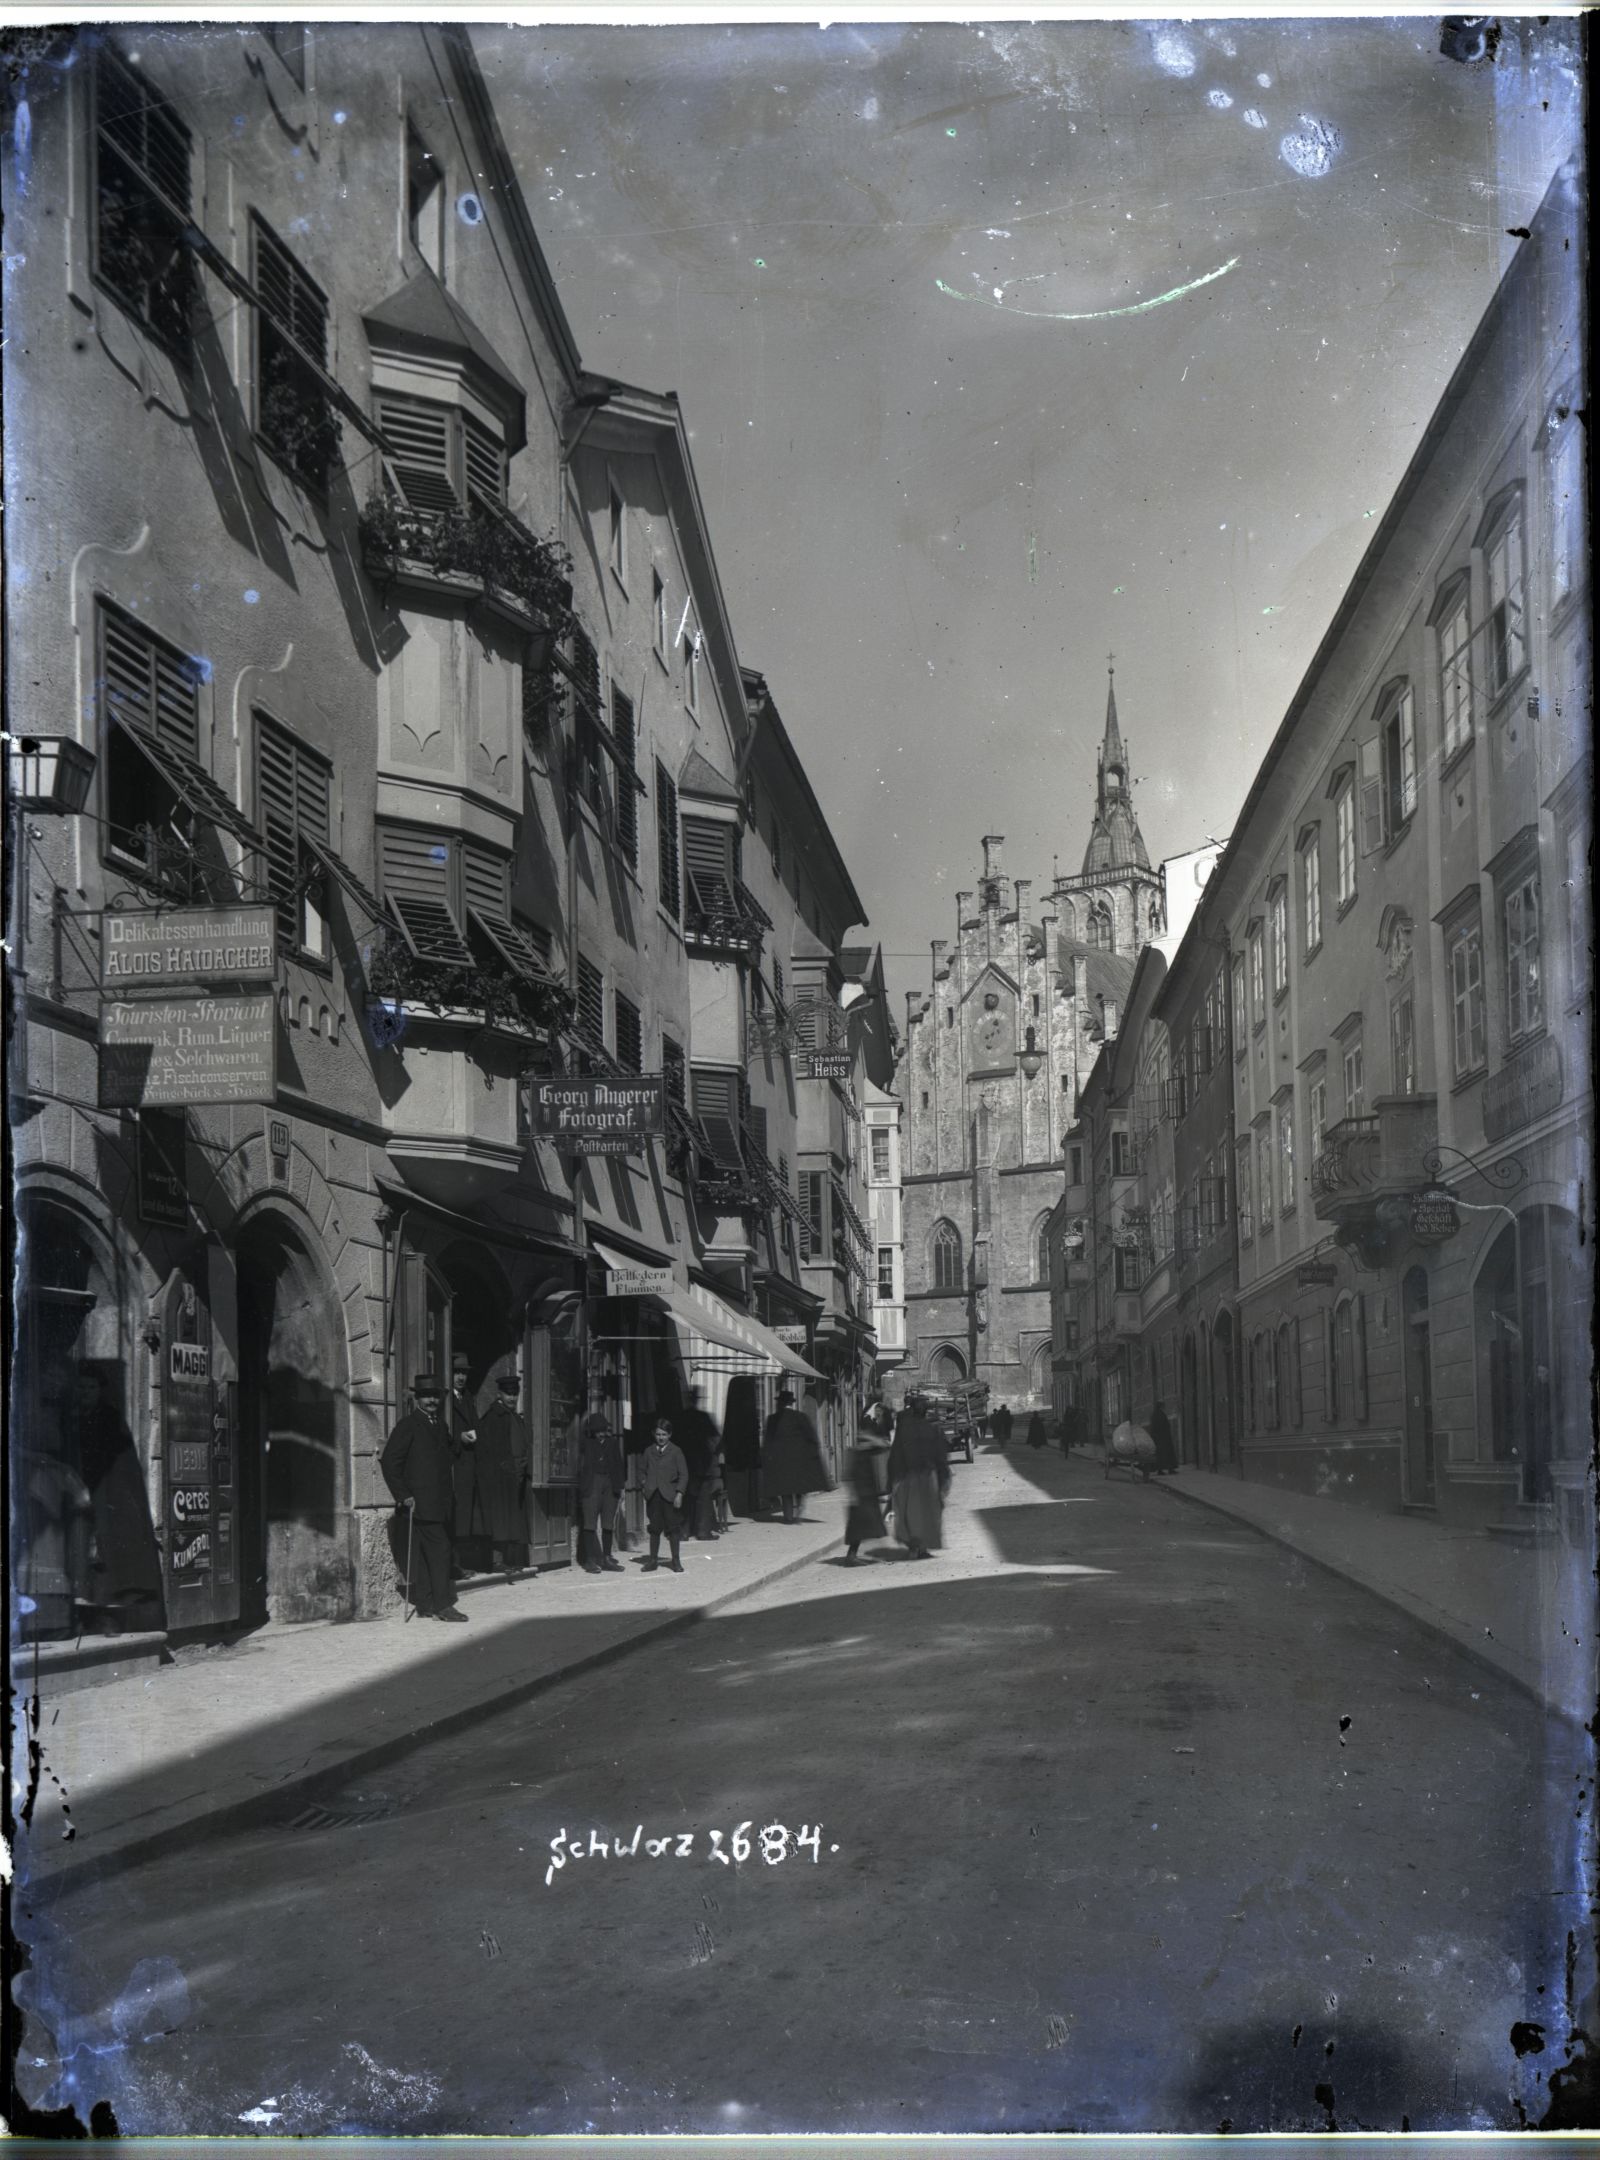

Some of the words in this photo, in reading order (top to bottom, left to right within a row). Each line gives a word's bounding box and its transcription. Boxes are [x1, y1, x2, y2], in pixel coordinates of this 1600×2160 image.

[108, 915, 269, 943] Delikatessenhandlung
[105, 950, 163, 976] ALOIS
[166, 945, 273, 973] HAIDACHER
[808, 1054, 851, 1063] Sebastian
[814, 1062, 846, 1077] Heiss
[539, 1084, 588, 1107] Georg
[594, 1083, 659, 1107] Angerer
[557, 1107, 637, 1130] Fotograf.
[173, 1348, 209, 1377] MAGGI
[173, 1490, 210, 1521] Ceres
[173, 1533, 210, 1569] KUNEROL
